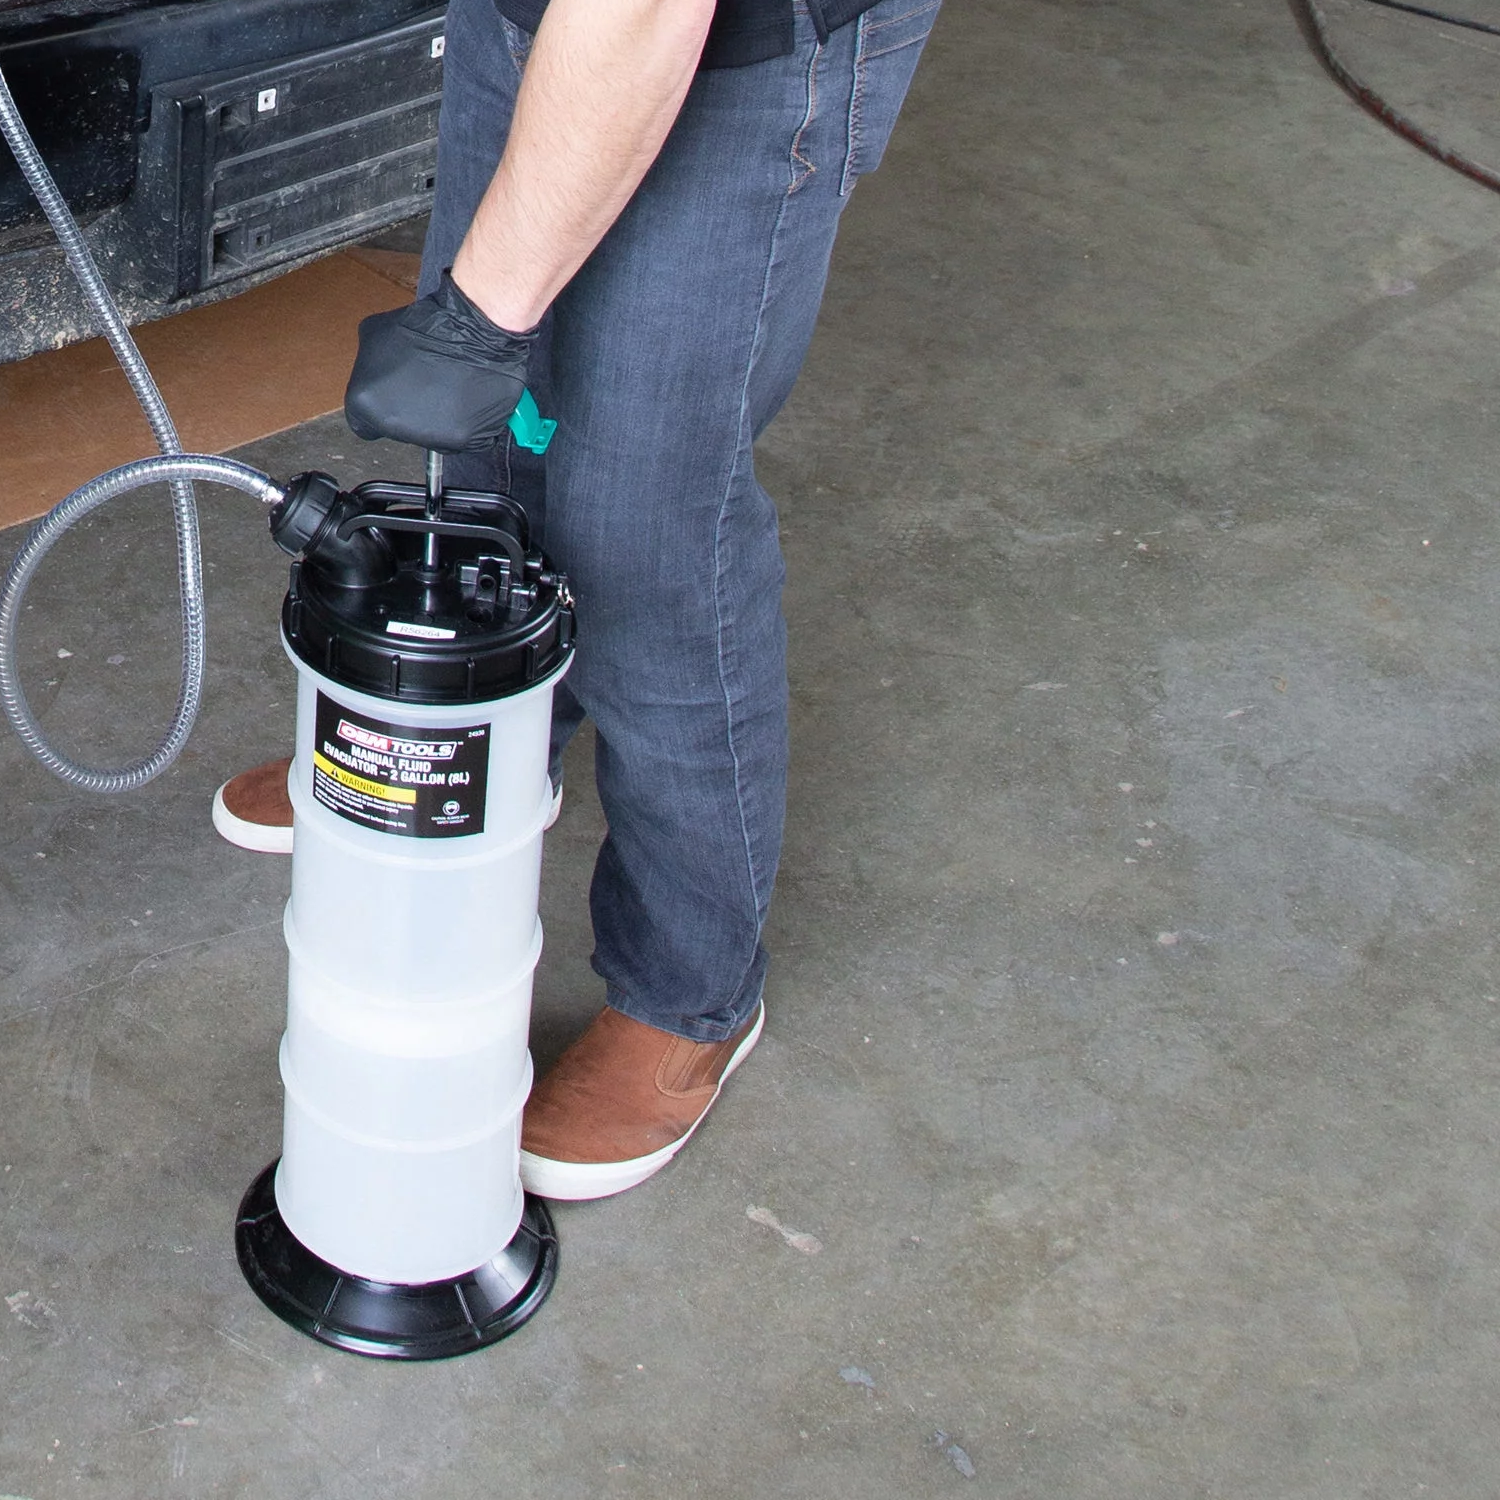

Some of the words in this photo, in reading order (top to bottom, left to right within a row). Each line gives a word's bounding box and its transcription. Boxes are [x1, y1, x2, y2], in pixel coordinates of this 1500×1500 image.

[324, 741, 378, 776] EVACUATOR
[390, 769, 398, 781] 2
[401, 771, 446, 785] GALLON
[447, 773, 470, 788] (8L)
[351, 744, 396, 769] MANUAL
[398, 758, 432, 773] FLUID
[341, 773, 385, 796] WARNING!
